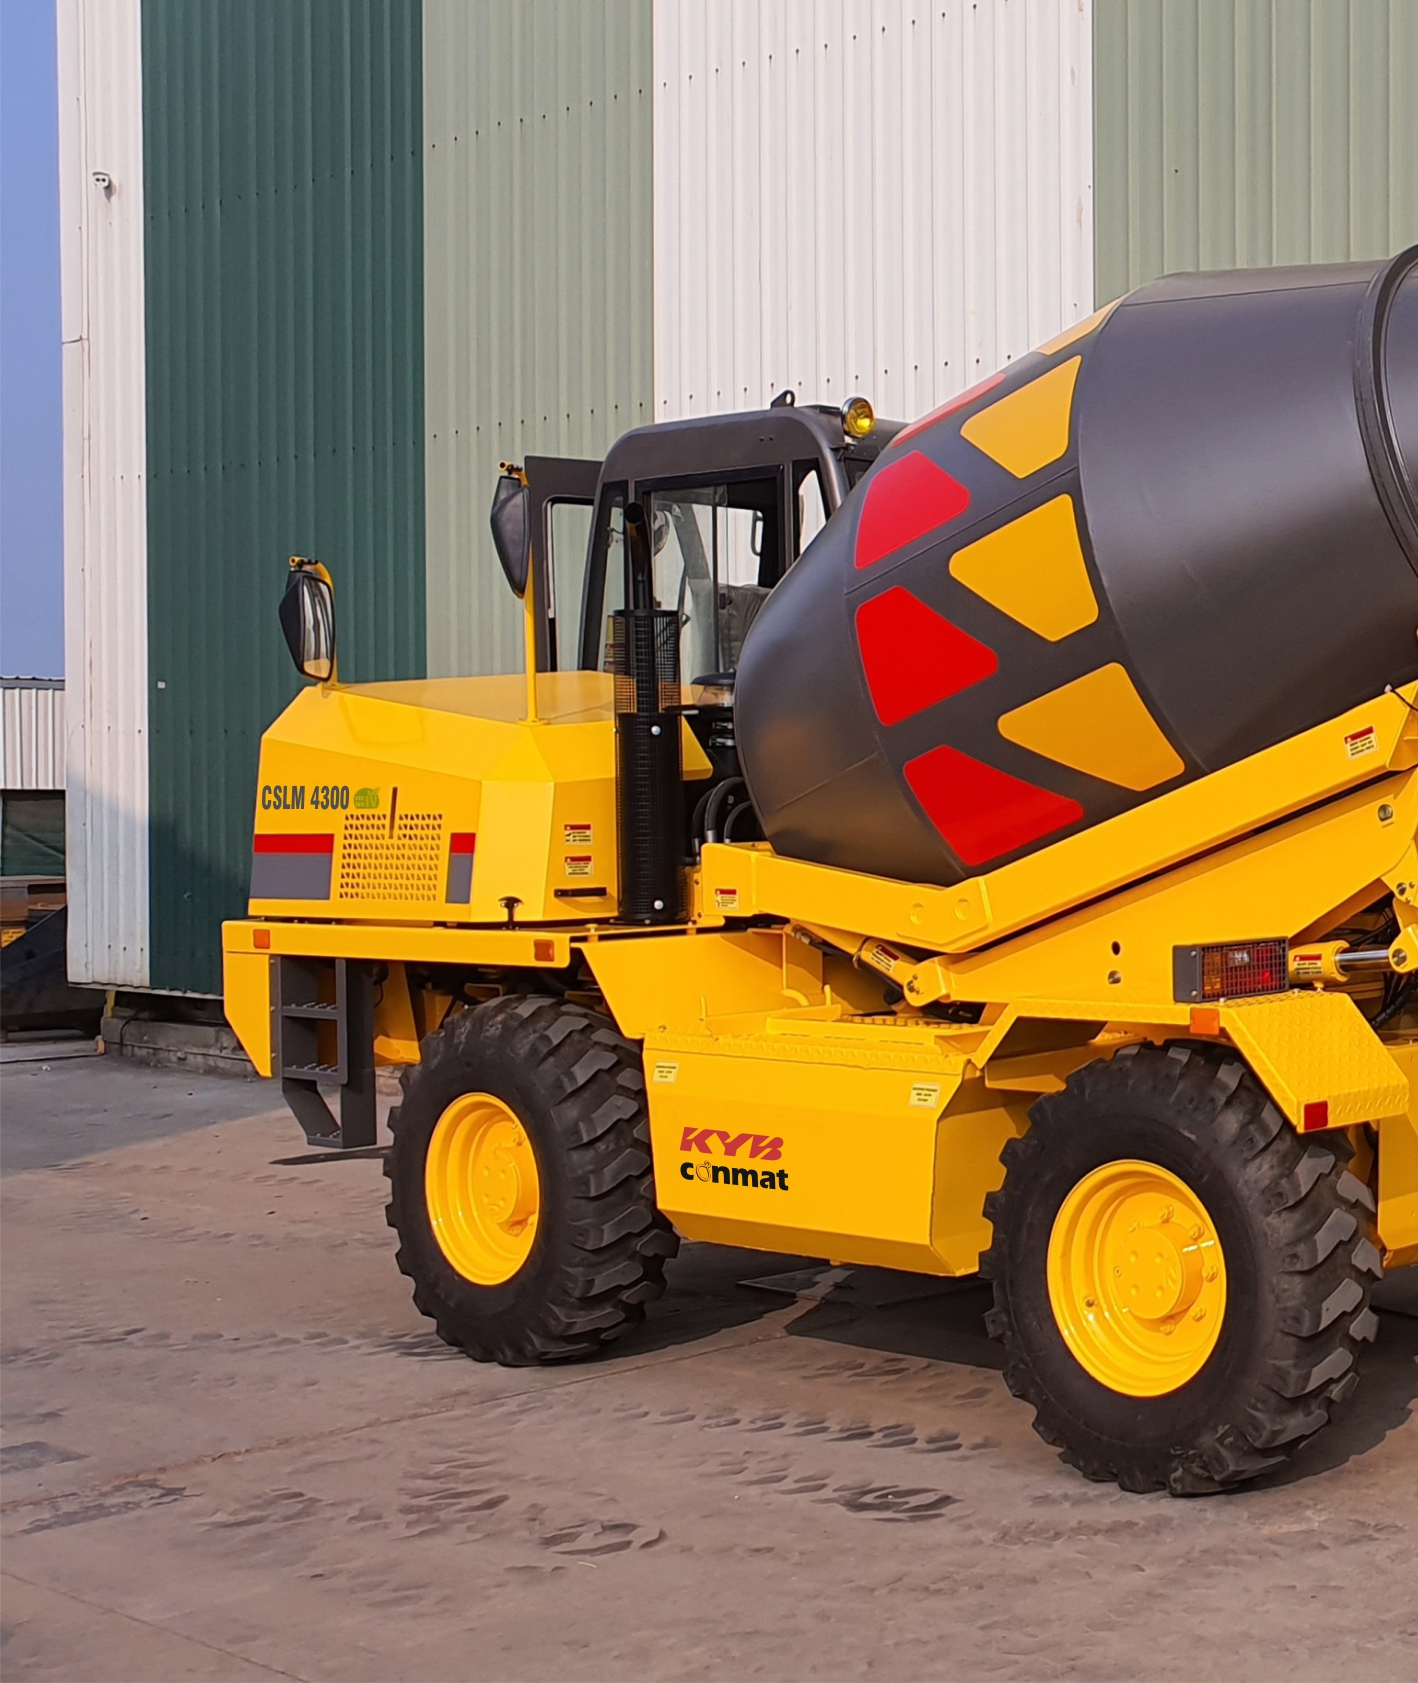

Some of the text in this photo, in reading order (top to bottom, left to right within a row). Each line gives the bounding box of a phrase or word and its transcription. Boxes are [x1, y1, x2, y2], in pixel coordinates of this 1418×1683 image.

[261, 785, 350, 810] CSLM 4300
[680, 1126, 784, 1161] KYB
[680, 1160, 789, 1191] conmat
